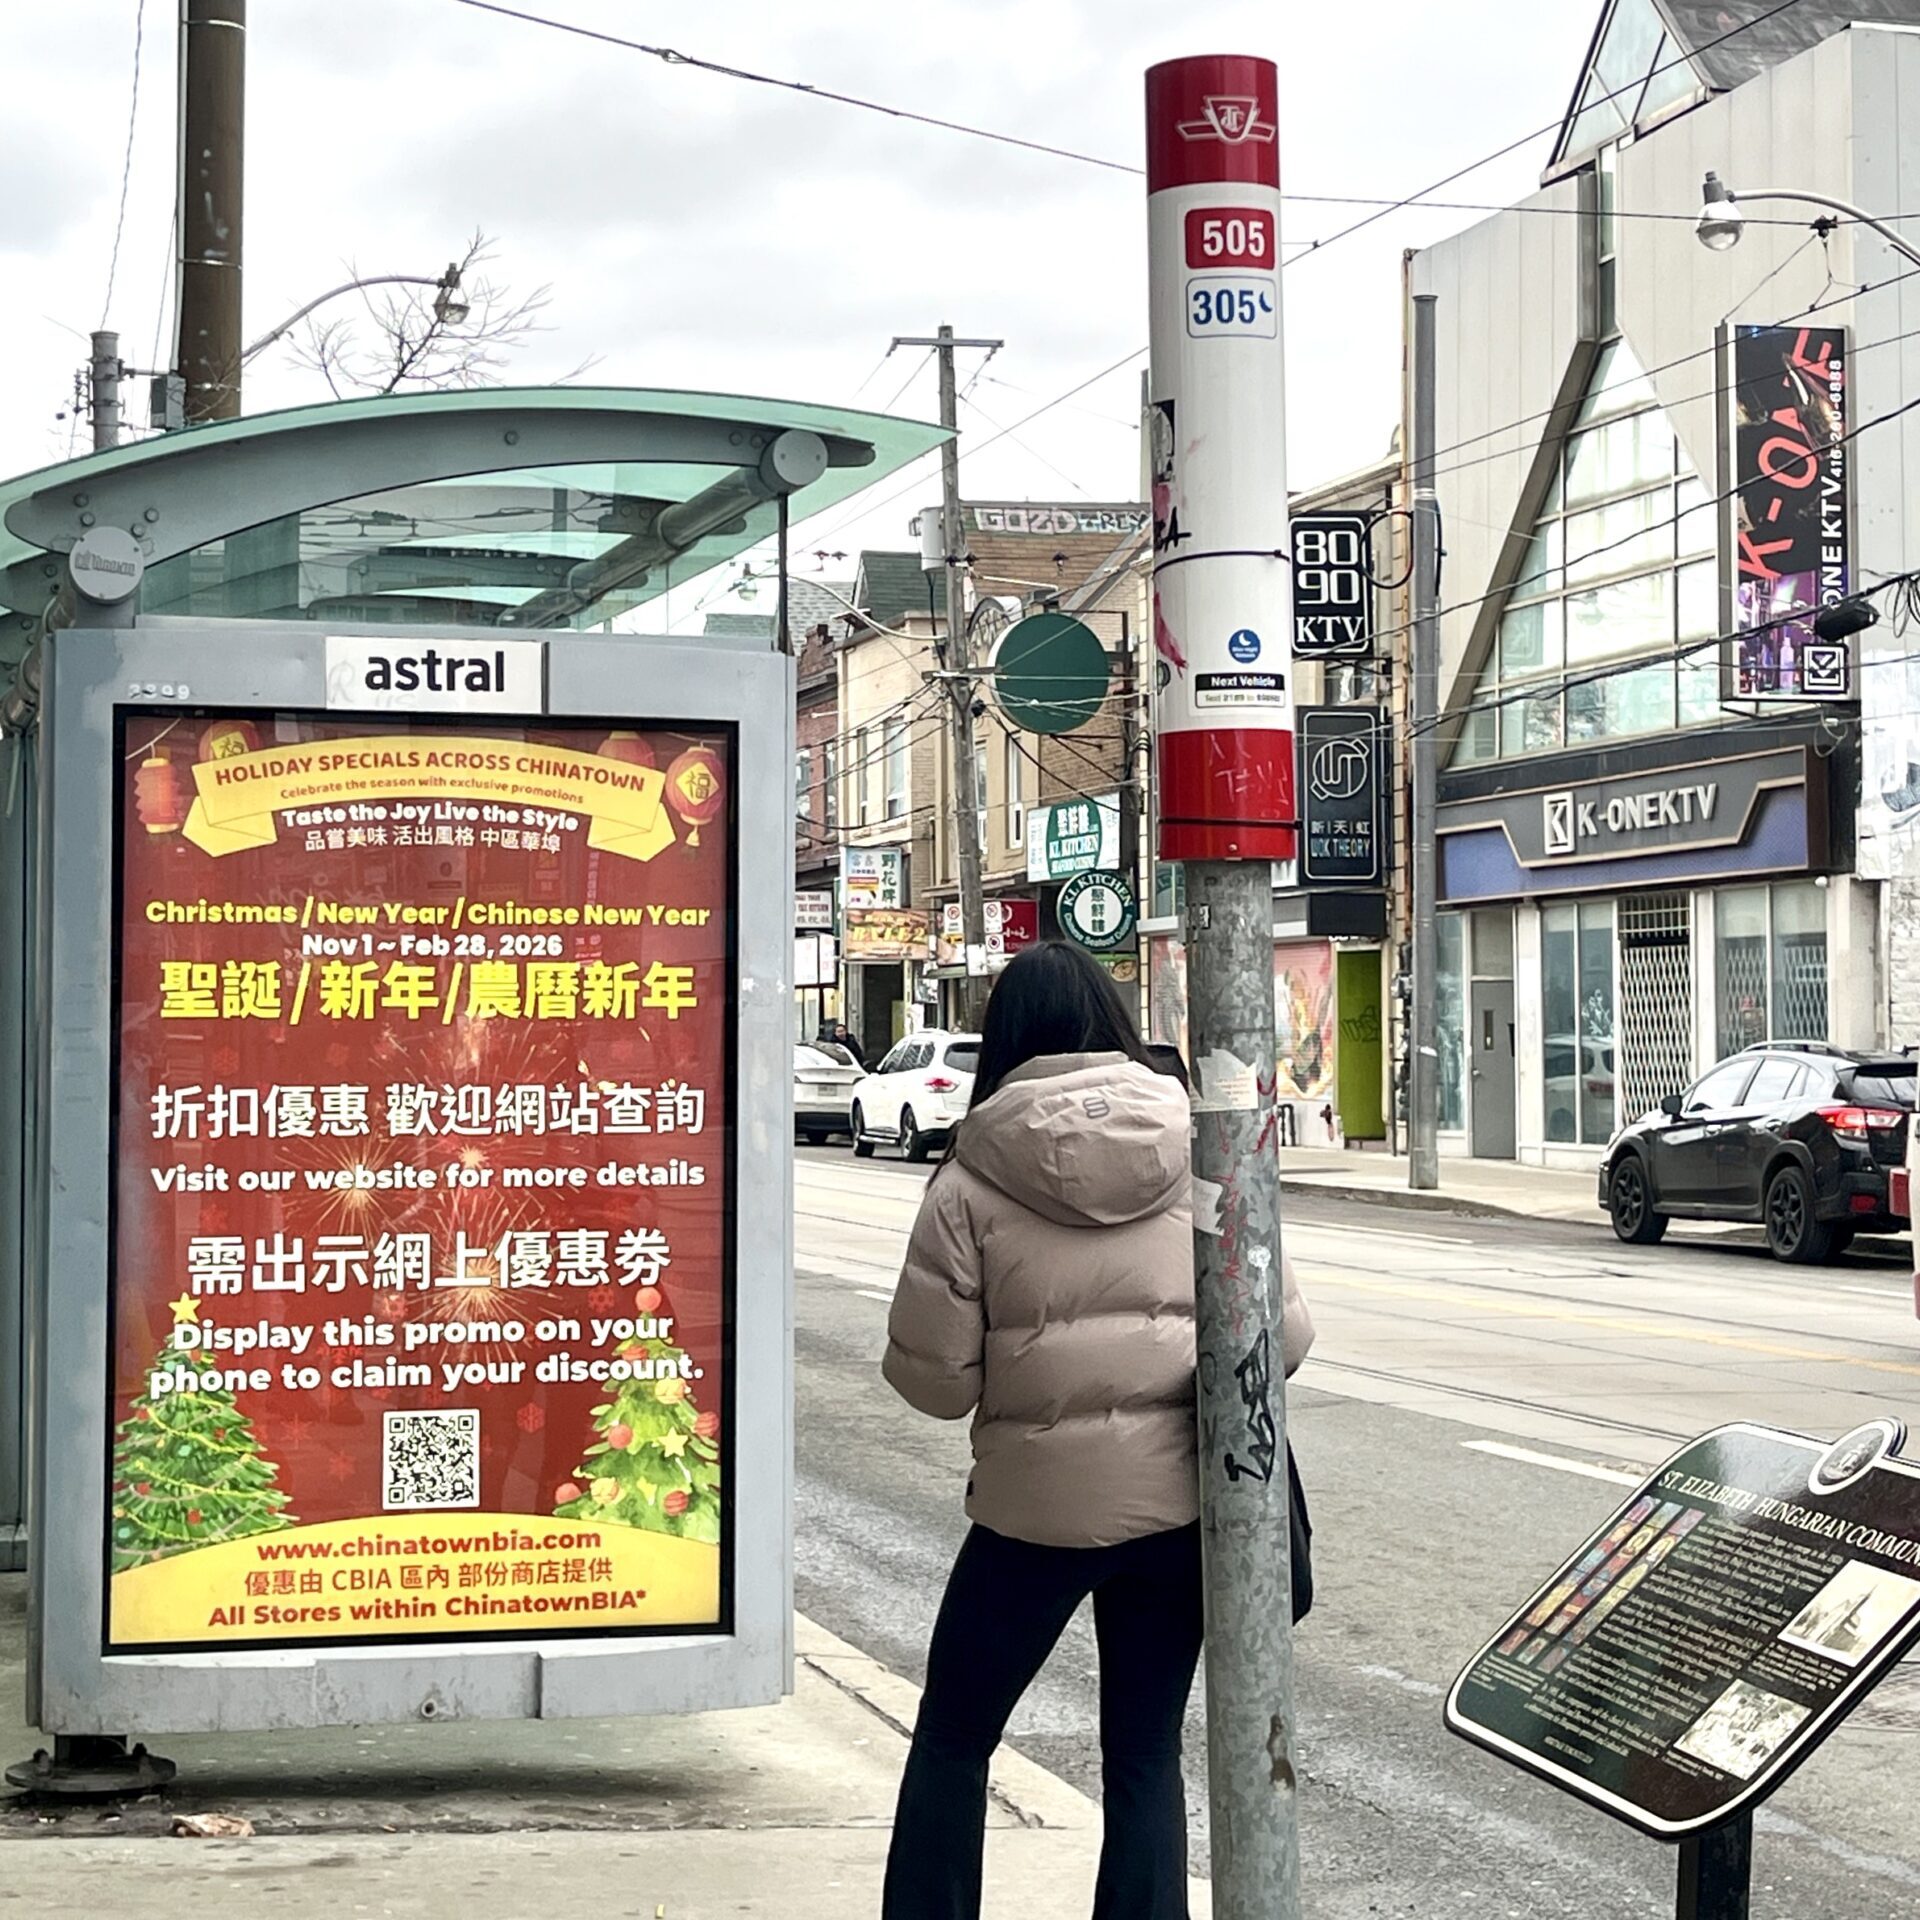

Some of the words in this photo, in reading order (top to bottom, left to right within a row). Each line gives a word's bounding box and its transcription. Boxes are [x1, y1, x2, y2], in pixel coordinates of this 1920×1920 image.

[1203, 219, 1265, 257] 505
[1193, 289, 1256, 325] 305
[1821, 476, 1843, 539] KTV
[1295, 530, 1359, 566] 80
[1297, 569, 1360, 605] 90
[1295, 616, 1365, 643] KTV
[365, 649, 504, 691] astral
[1211, 676, 1237, 687] Next
[1239, 675, 1276, 687] Vehicle
[215, 757, 313, 787] HOLIDAY
[318, 751, 420, 771] SPECIALS
[425, 751, 510, 771] ACROSS
[516, 756, 645, 792] CHINATOWN
[280, 782, 342, 799] Celebrate
[345, 778, 367, 790] the
[370, 777, 415, 788] season
[418, 775, 447, 787] with
[449, 778, 509, 791] exclusive
[511, 781, 584, 804] promotions
[282, 806, 347, 828] Taste
[349, 802, 388, 820] the
[391, 802, 432, 825] Joy
[434, 801, 481, 820] Live
[482, 804, 520, 824] the
[522, 809, 579, 833] Style
[1578, 783, 1717, 837] K-ONEKTV
[392, 825, 475, 847] 活出風格
[480, 828, 562, 854] 中區華埠
[881, 853, 897, 909] 野花牌
[1063, 885, 1079, 907] KL
[1077, 873, 1133, 907] KITCHEN
[584, 904, 642, 926] New
[646, 905, 710, 926] Year
[302, 934, 358, 956] Nov
[361, 934, 373, 956] 1
[400, 934, 450, 956] Feb
[454, 934, 494, 959] 28,
[499, 934, 563, 956] 2026
[150, 1085, 371, 1139] 折扣優惠
[385, 1082, 705, 1136] 歡迎網站查詢
[151, 1163, 229, 1191] Visit
[238, 1167, 296, 1190] our
[306, 1161, 437, 1190] website
[445, 1161, 493, 1188] for
[502, 1165, 587, 1187] more
[596, 1159, 705, 1186] details
[173, 1323, 315, 1353] Display
[323, 1319, 394, 1347] this
[405, 1321, 526, 1352] promo
[535, 1324, 581, 1342] on
[591, 1318, 674, 1348] your
[150, 1365, 270, 1399] phone
[282, 1367, 319, 1390] to
[331, 1361, 432, 1387] claim
[441, 1364, 527, 1393] your
[535, 1353, 704, 1383] discount.
[1657, 1470, 1679, 1489] ST.
[1678, 1475, 1756, 1511] ELIZABETH
[1753, 1497, 1853, 1541] HUNGARIAN
[257, 1530, 601, 1561] www.chinatownbia.com
[244, 1568, 324, 1596] 優惠由
[331, 1567, 393, 1591] CBIA
[400, 1564, 451, 1590] 區內
[458, 1556, 613, 1588] 部份商店提供
[208, 1605, 245, 1627] All
[254, 1602, 341, 1625] Stores
[350, 1597, 437, 1621] within
